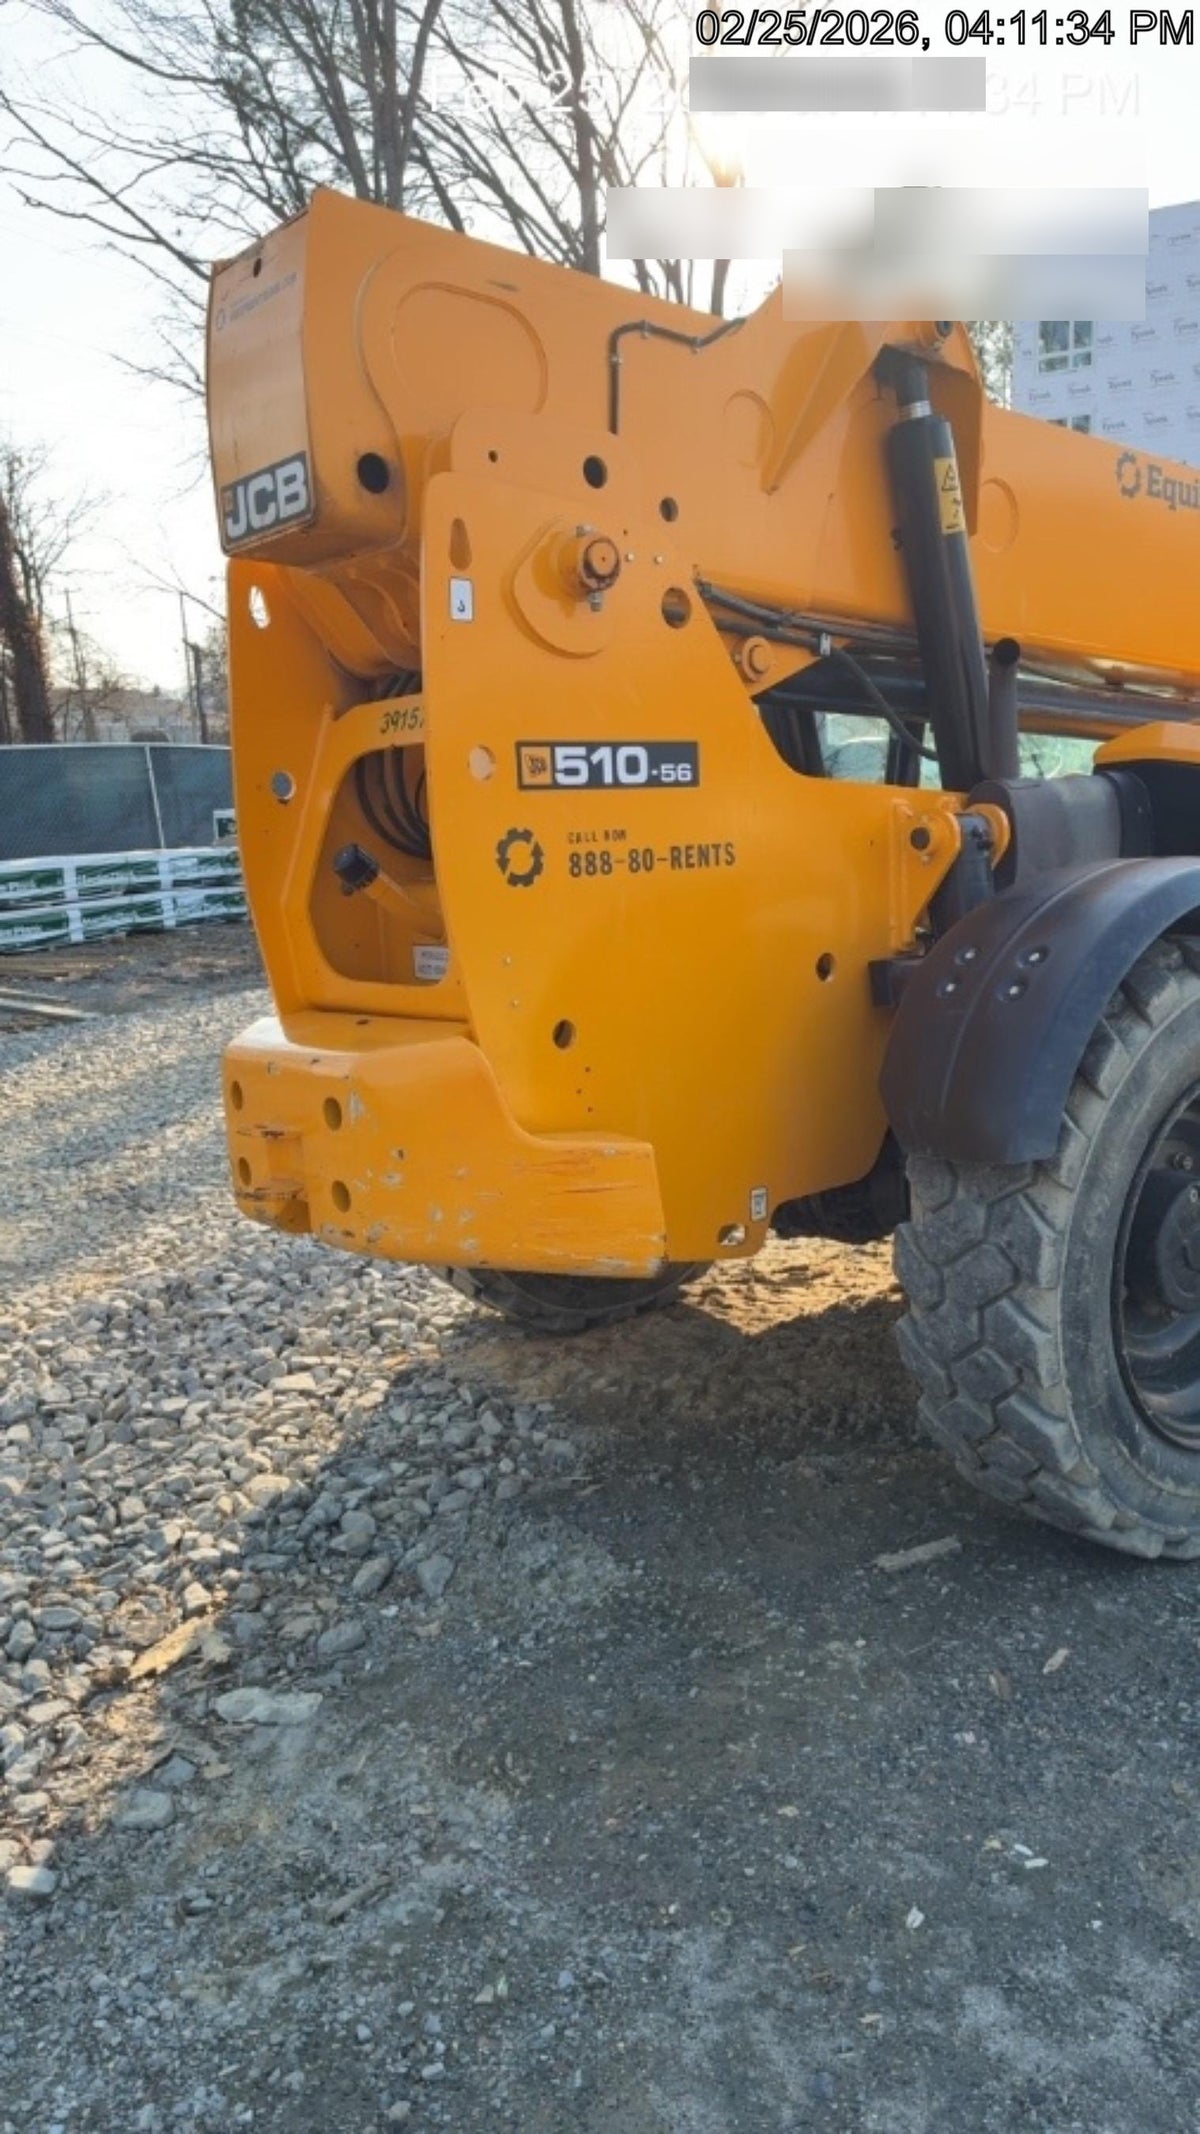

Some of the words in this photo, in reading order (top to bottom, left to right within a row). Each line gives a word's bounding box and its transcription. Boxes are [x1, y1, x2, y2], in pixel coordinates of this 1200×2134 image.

[226, 459, 309, 538] JCB
[1147, 463, 1200, 512] Equi
[568, 842, 736, 878] 888-80-RENTS
